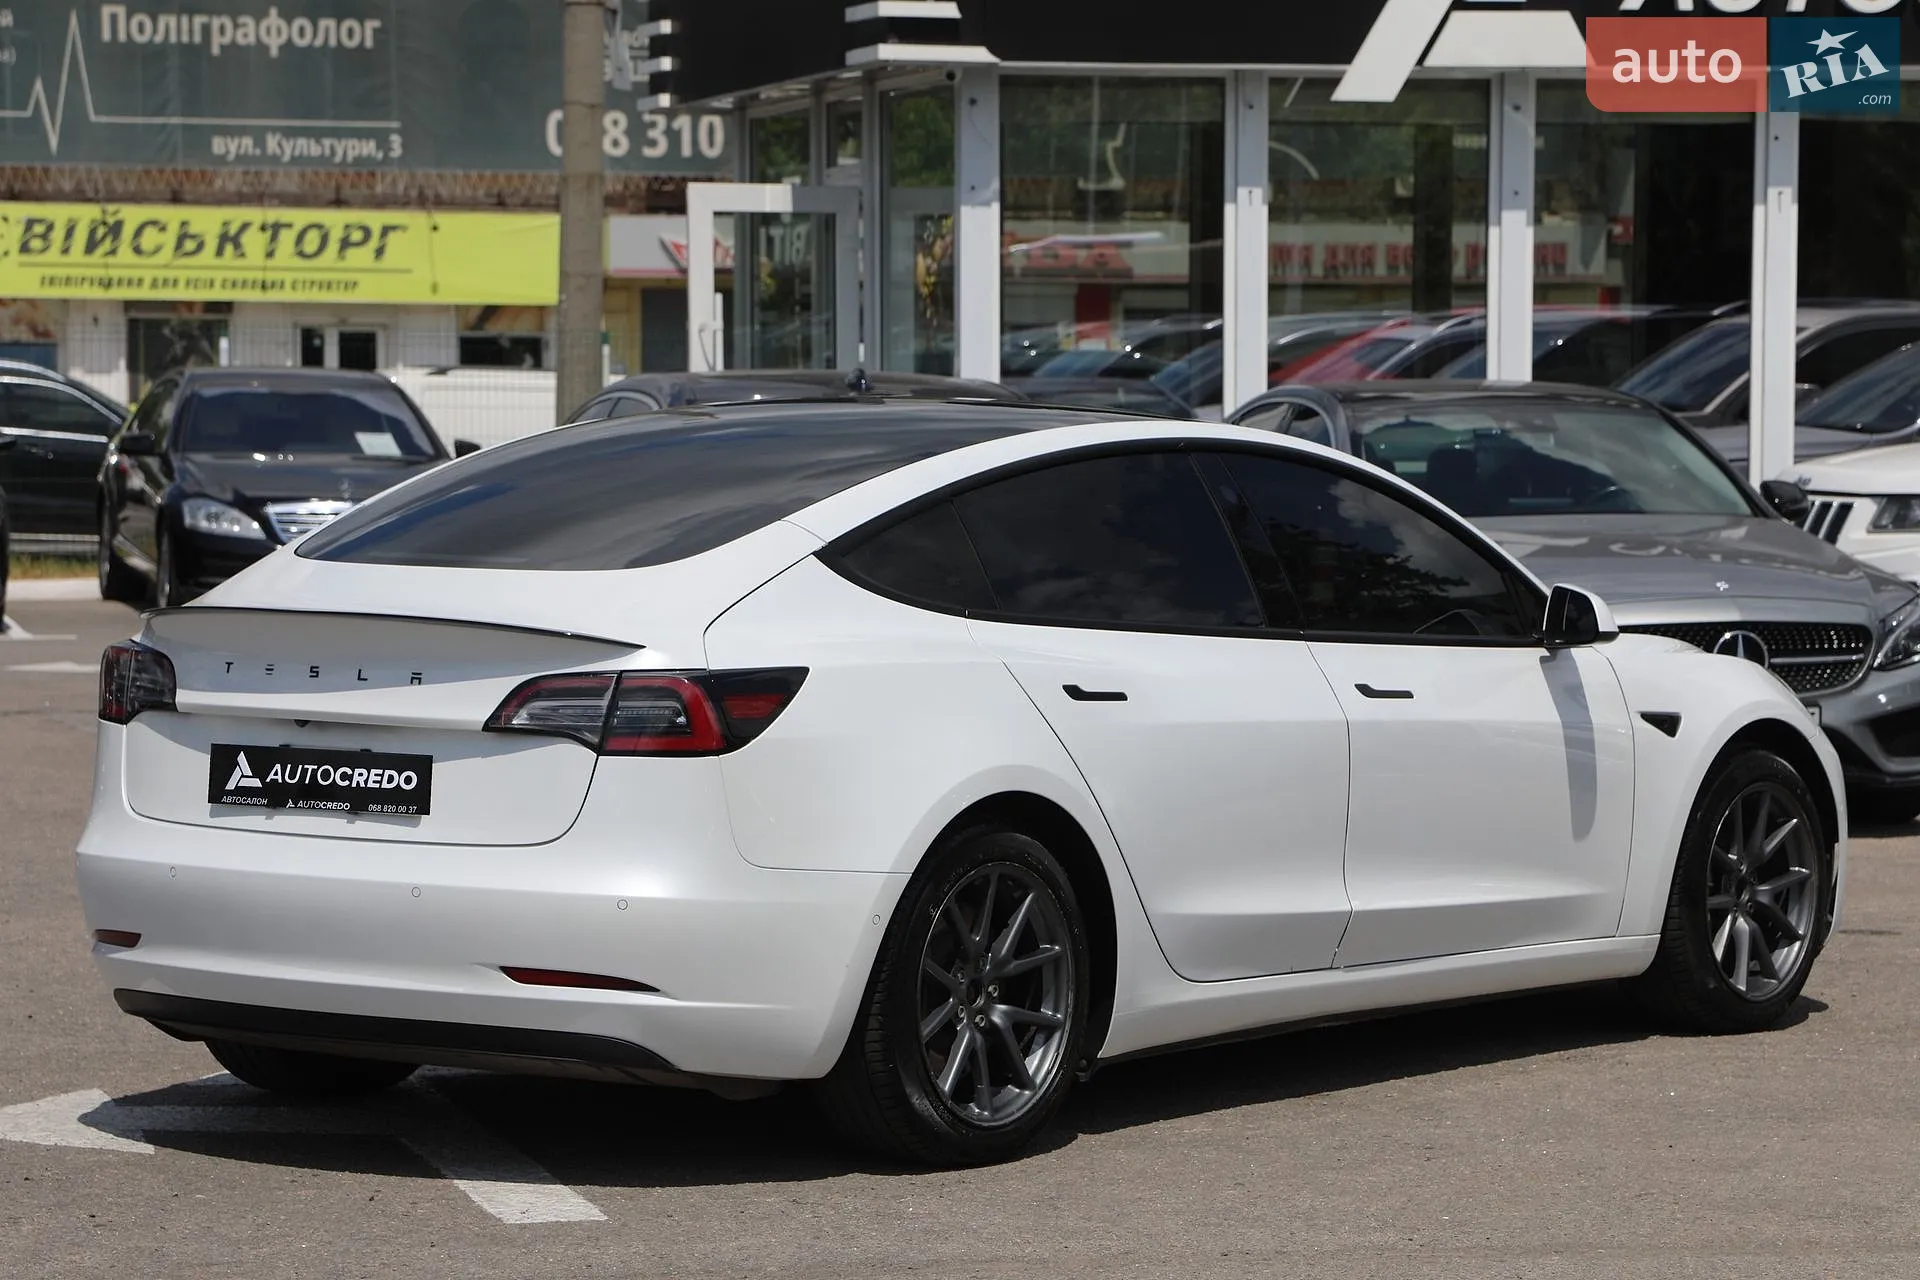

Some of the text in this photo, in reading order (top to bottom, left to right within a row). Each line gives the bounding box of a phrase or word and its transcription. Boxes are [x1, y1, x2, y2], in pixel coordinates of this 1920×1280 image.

[99, 4, 382, 58] Поліграфолог
[545, 108, 725, 159] 08 310
[211, 131, 403, 163] вул. Культури, 3
[224, 661, 423, 686] TESLA
[265, 763, 418, 790] AUTOCREDO
[221, 795, 268, 806] АВТОСАЛОН
[296, 799, 351, 811] AUTOCREDO
[368, 803, 382, 812] 068
